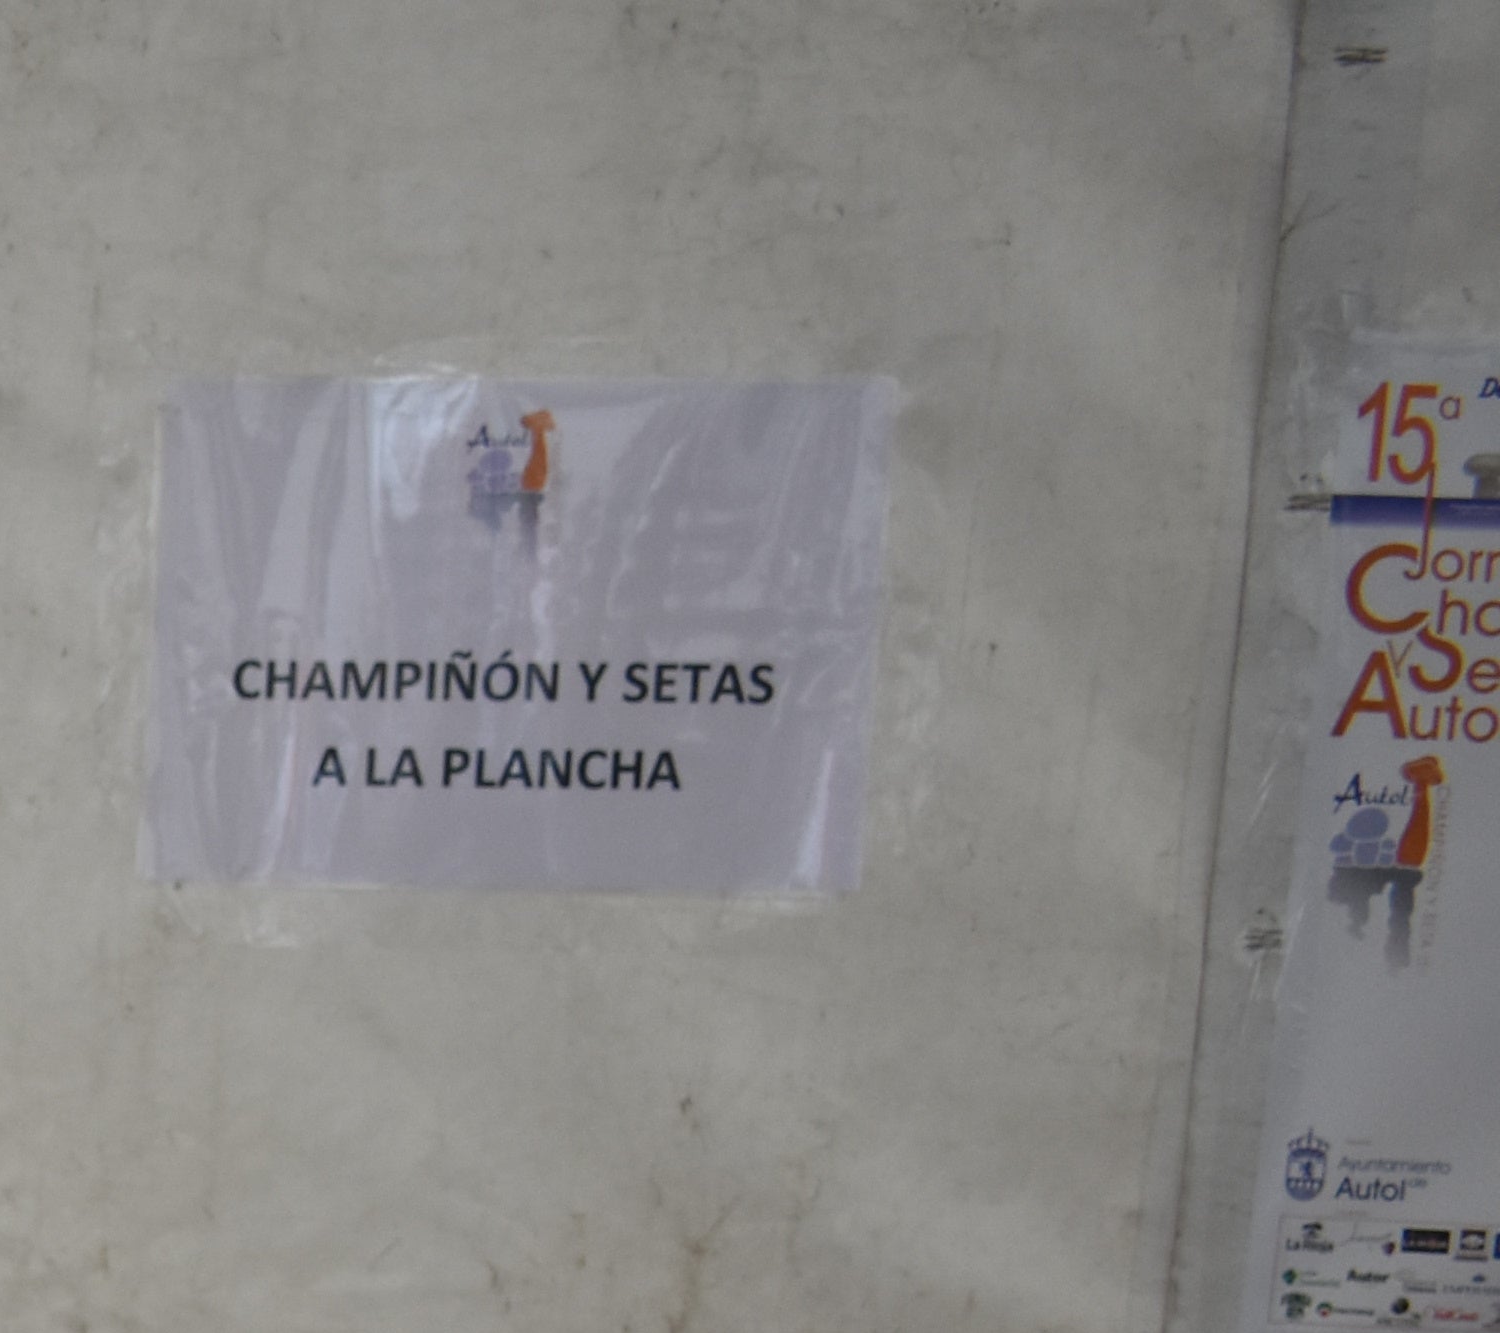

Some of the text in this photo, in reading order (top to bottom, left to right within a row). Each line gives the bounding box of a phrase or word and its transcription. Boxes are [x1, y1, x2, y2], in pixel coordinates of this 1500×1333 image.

[232, 650, 775, 705] CHAMPIÑÓN Y SETAS
[1330, 650, 1500, 744] Auto
[312, 748, 684, 791] A LA PLANCHA
[1337, 1155, 1452, 1176] Ayuntamiento
[1333, 1175, 1407, 1201] Autol
